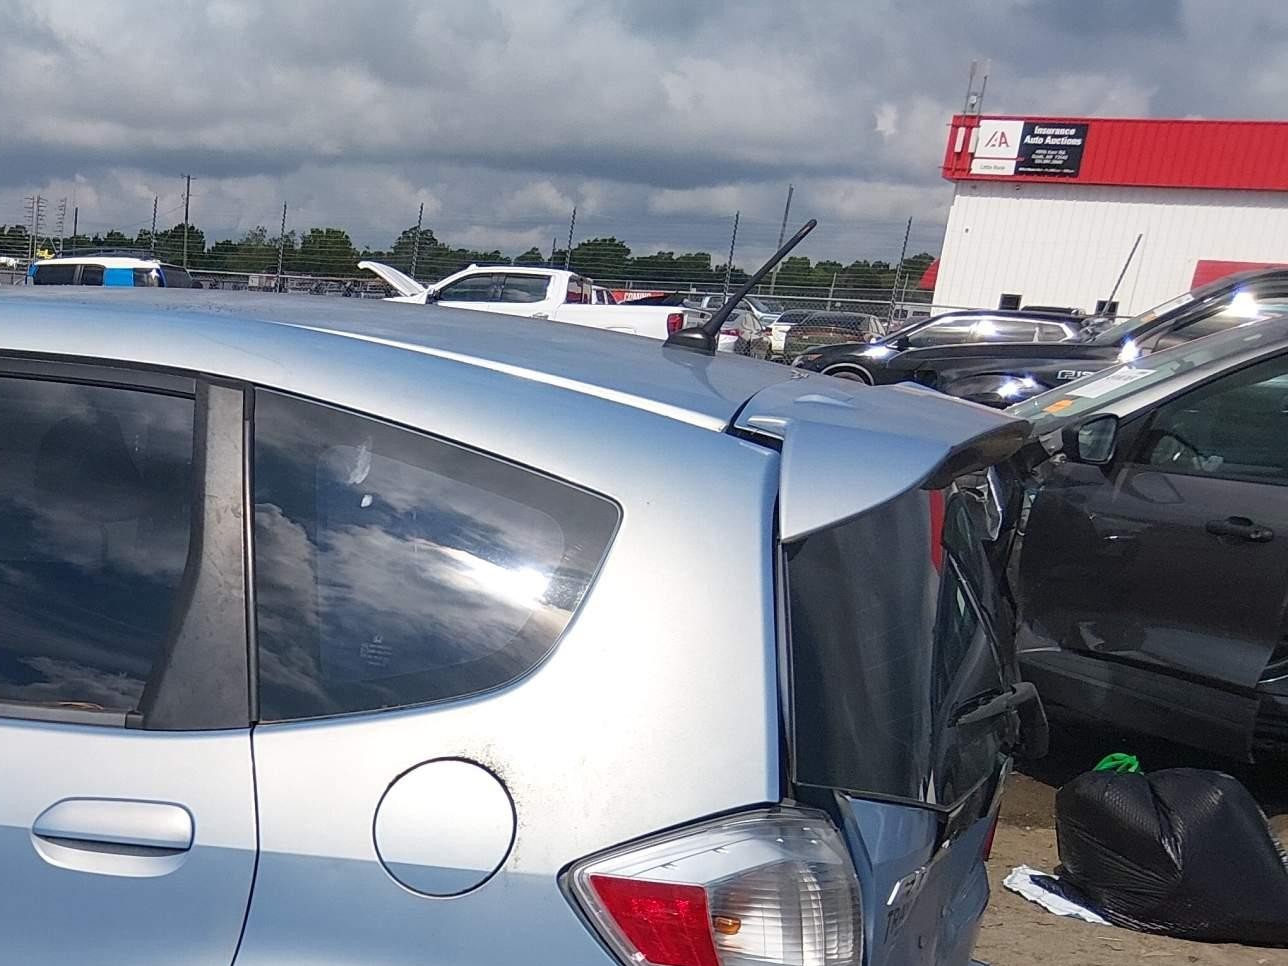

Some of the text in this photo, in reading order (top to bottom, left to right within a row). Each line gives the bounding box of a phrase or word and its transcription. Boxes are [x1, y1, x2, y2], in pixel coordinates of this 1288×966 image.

[1034, 125, 1077, 135] Insurance
[1023, 135, 1083, 146] Auto Auctions
